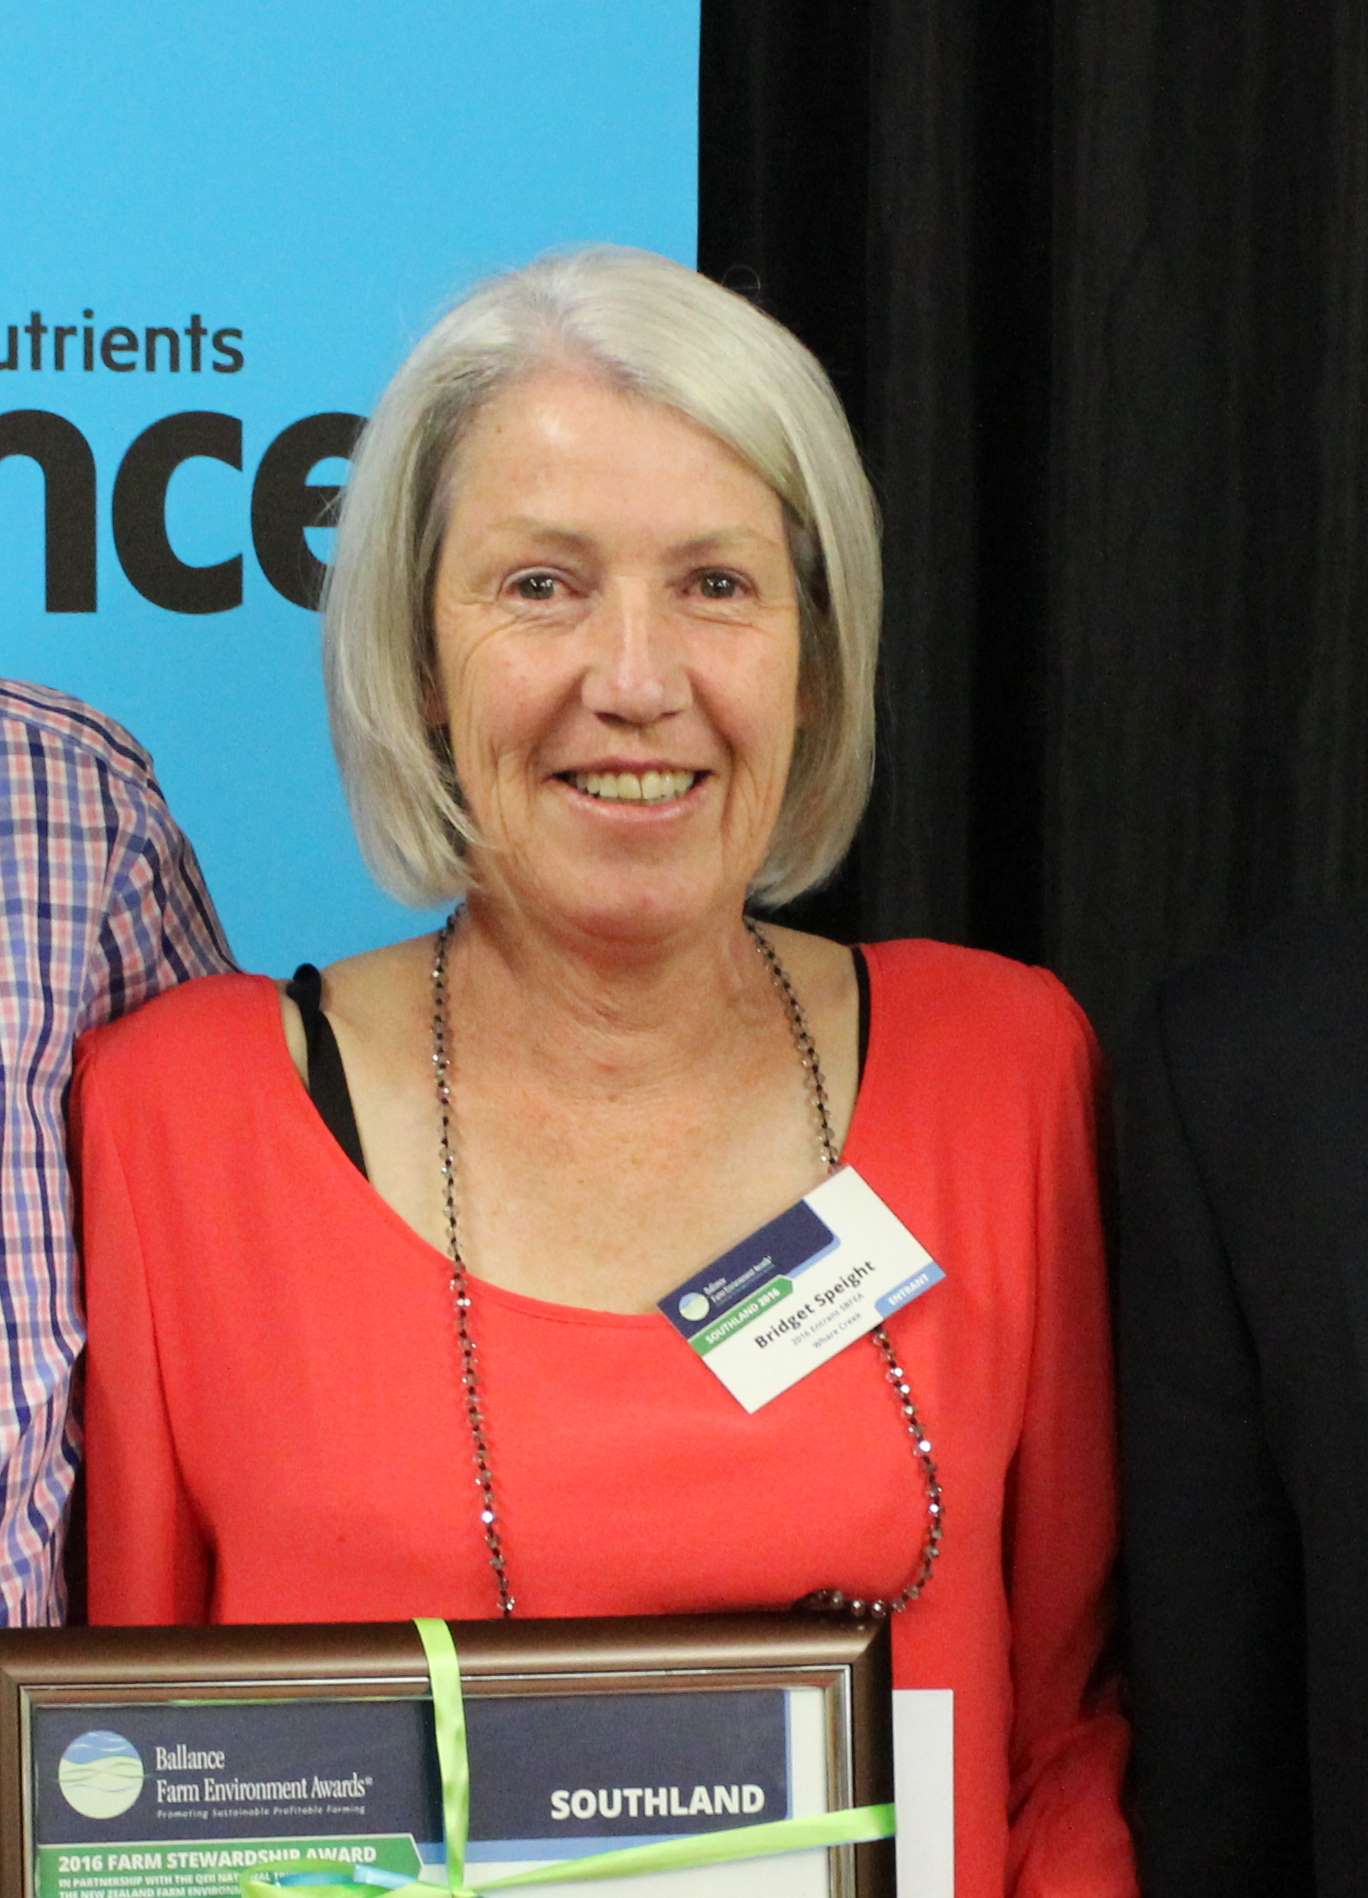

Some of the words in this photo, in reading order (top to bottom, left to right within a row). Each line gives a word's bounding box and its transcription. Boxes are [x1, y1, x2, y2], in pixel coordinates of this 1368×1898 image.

[888, 1273, 929, 1305] ENTRANT
[755, 1303, 815, 1348] Bridget
[814, 1261, 875, 1307] Speight
[705, 1303, 759, 1344] SOUTHLAND
[156, 1744, 225, 1770] Ballance
[157, 1779, 200, 1803] Farm
[204, 1777, 308, 1802] Environment
[550, 1784, 766, 1820] SOUTHLAND
[157, 1808, 208, 1820] Promoting
[213, 1807, 270, 1818] Sustainable
[274, 1805, 322, 1815] Profitable
[326, 1804, 366, 1815] Farming
[58, 1855, 103, 1872] 2016
[108, 1853, 162, 1871] FARM
[167, 1849, 300, 1869] STEWARDSHIP
[306, 1846, 376, 1863] AWARD
[58, 1877, 71, 1889] IN
[73, 1876, 143, 1888] PARTNERSHIP
[145, 1875, 171, 1886] WITH
[175, 1874, 194, 1885] THE
[156, 1887, 186, 1897] FARM
